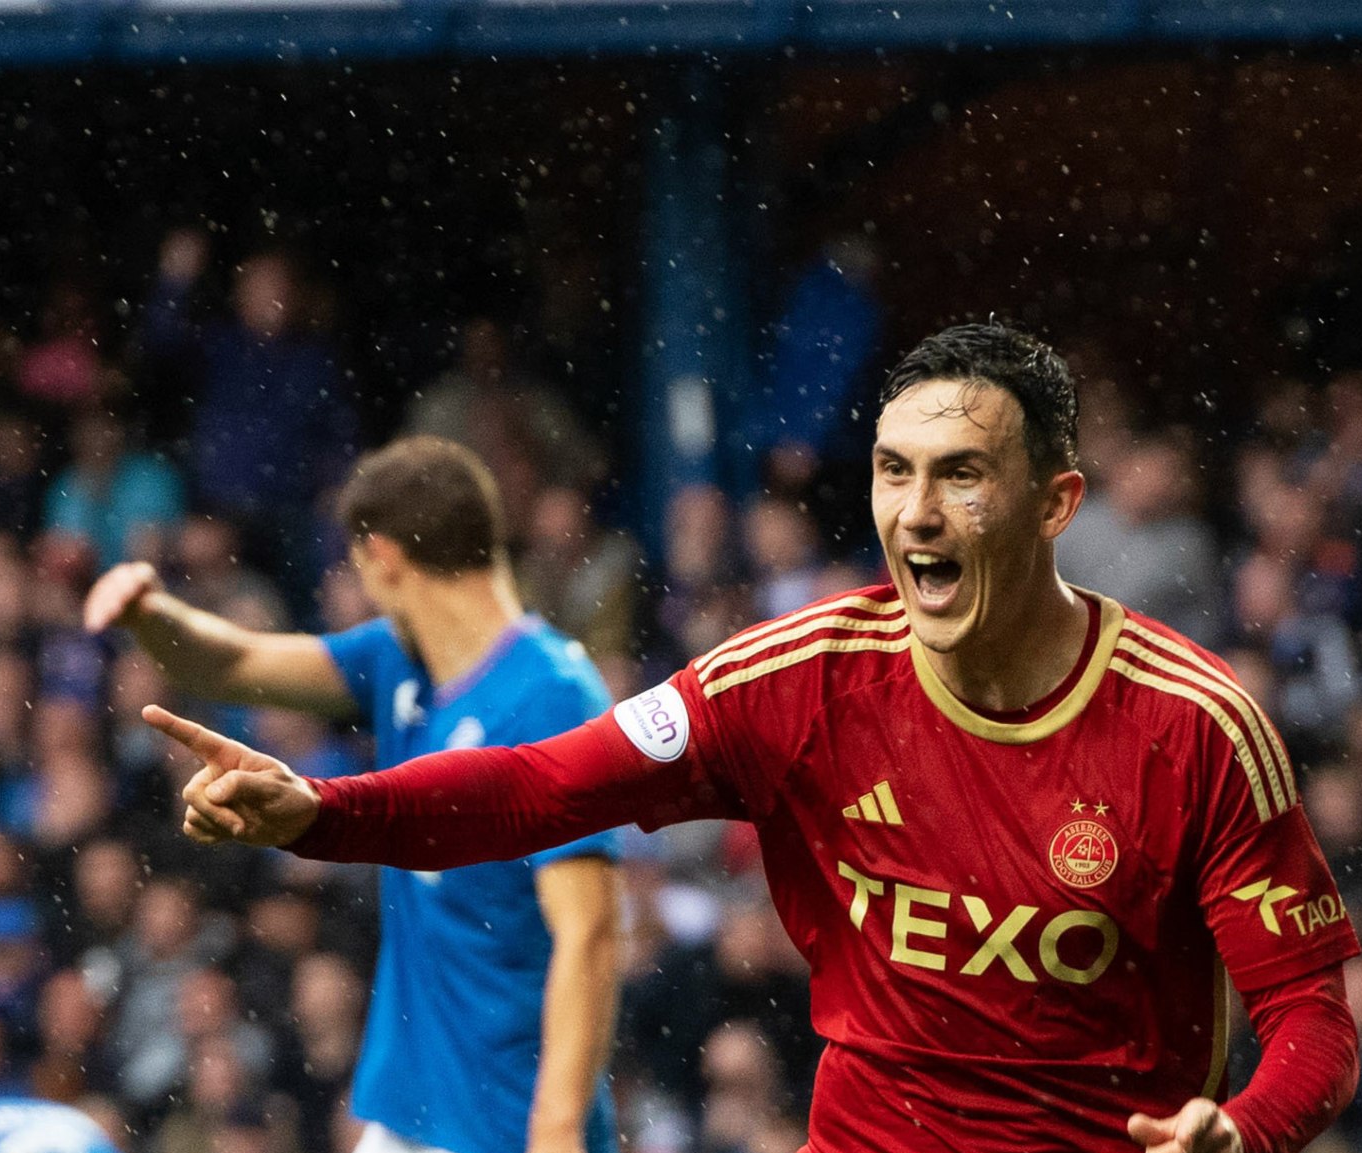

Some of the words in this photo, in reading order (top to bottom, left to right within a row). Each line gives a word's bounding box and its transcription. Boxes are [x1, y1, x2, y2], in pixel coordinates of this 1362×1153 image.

[1064, 823, 1110, 843] ABERDEEN
[1053, 854, 1094, 885] FOOTBALL
[1093, 857, 1113, 881] CLUB
[837, 860, 1120, 985] TEXO
